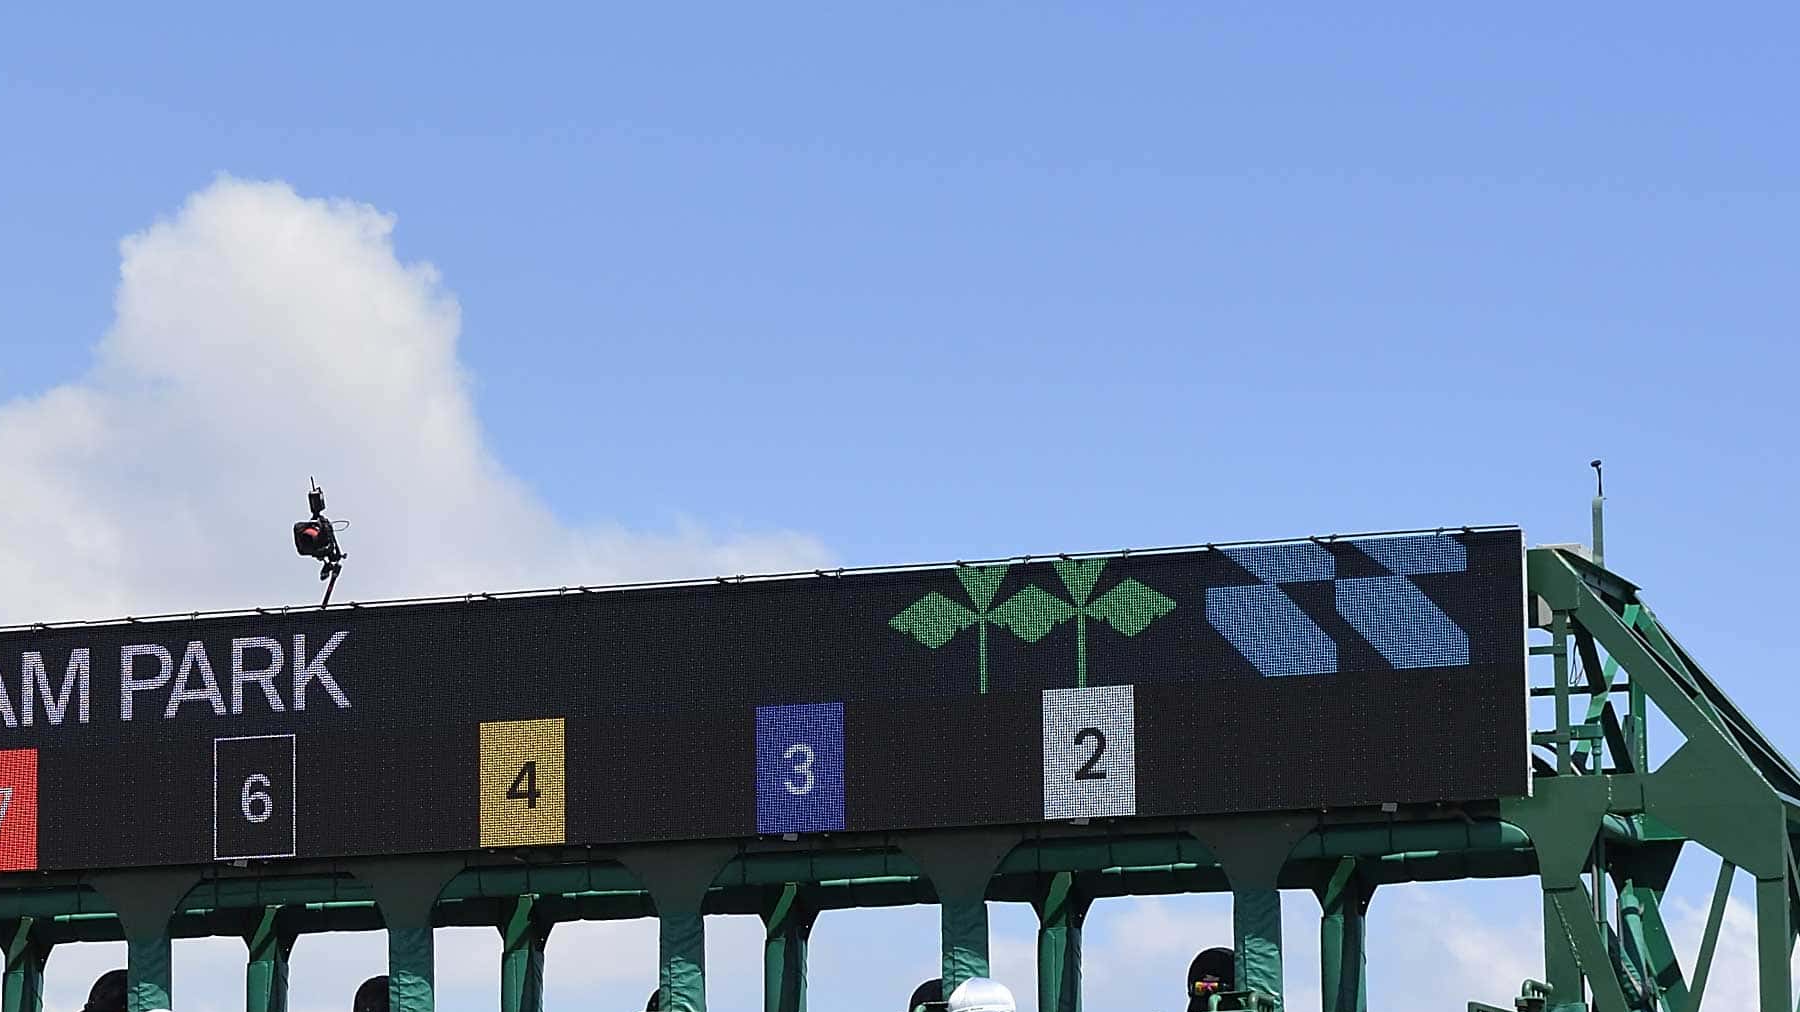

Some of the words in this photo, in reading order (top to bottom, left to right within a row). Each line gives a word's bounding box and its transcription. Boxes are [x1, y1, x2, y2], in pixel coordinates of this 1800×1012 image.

[120, 631, 352, 721] PARK
[783, 743, 815, 795] 3
[1073, 728, 1107, 780] 2
[241, 773, 273, 822] 6
[505, 760, 542, 809] 4
